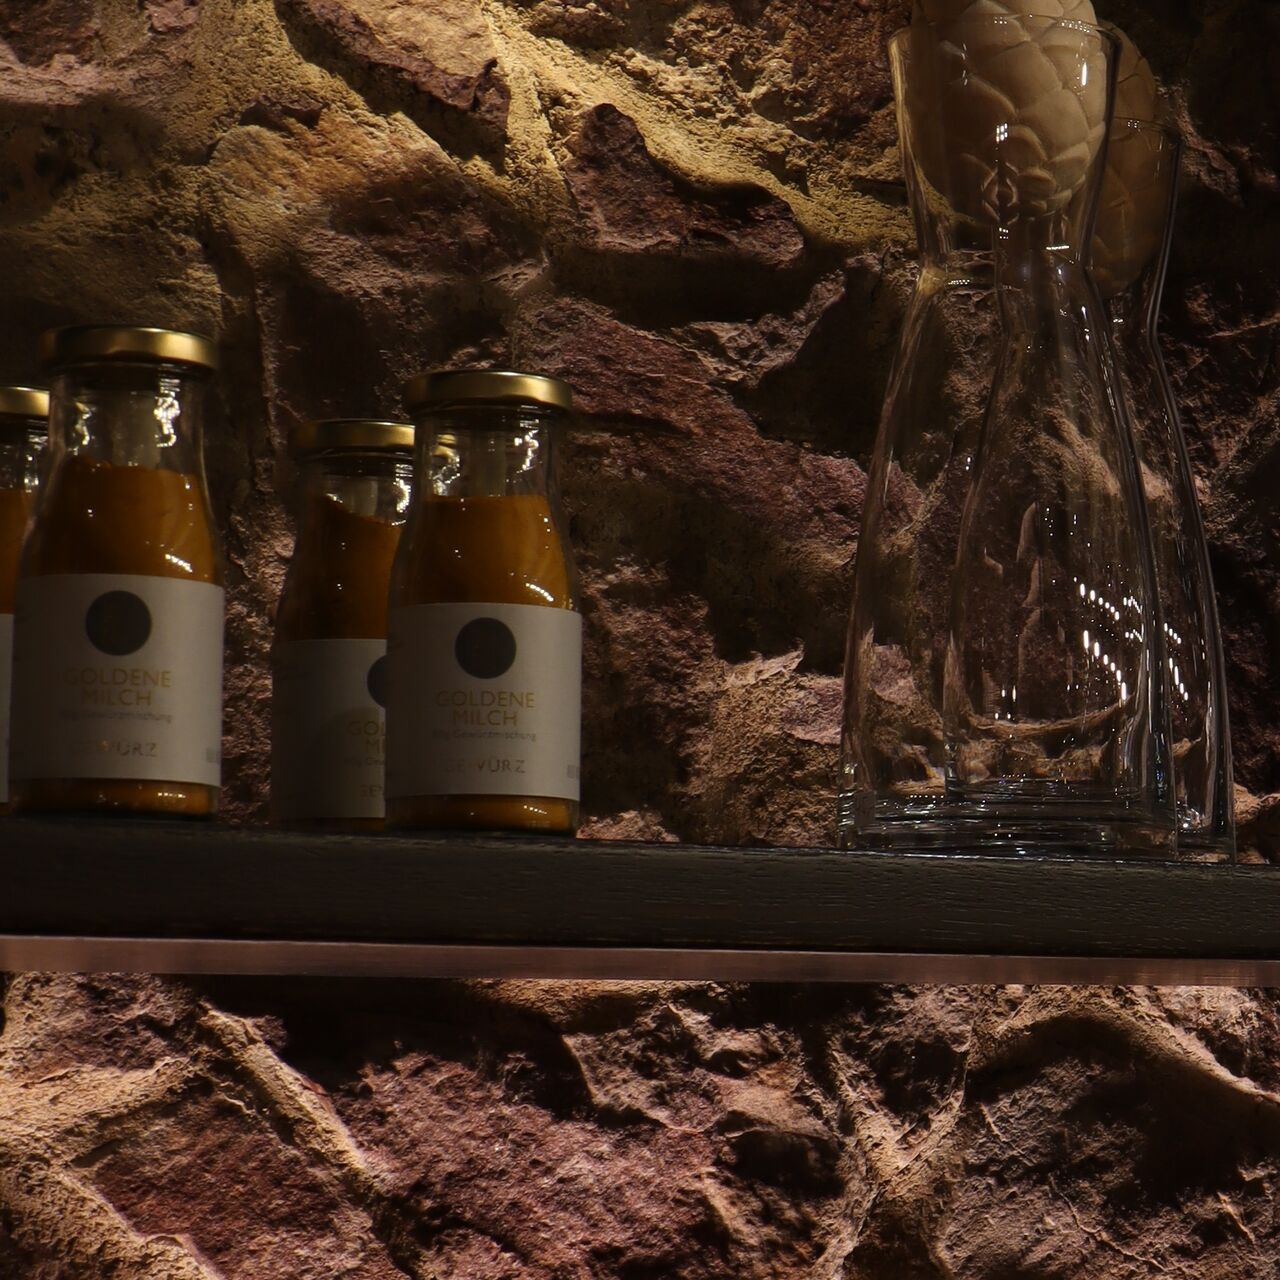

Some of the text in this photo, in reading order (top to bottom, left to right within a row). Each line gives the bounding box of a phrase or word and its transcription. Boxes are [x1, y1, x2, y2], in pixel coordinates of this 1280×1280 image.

[64, 666, 173, 689] GOLDENE
[434, 690, 536, 709] GOLDENE
[453, 709, 519, 727] MILCH
